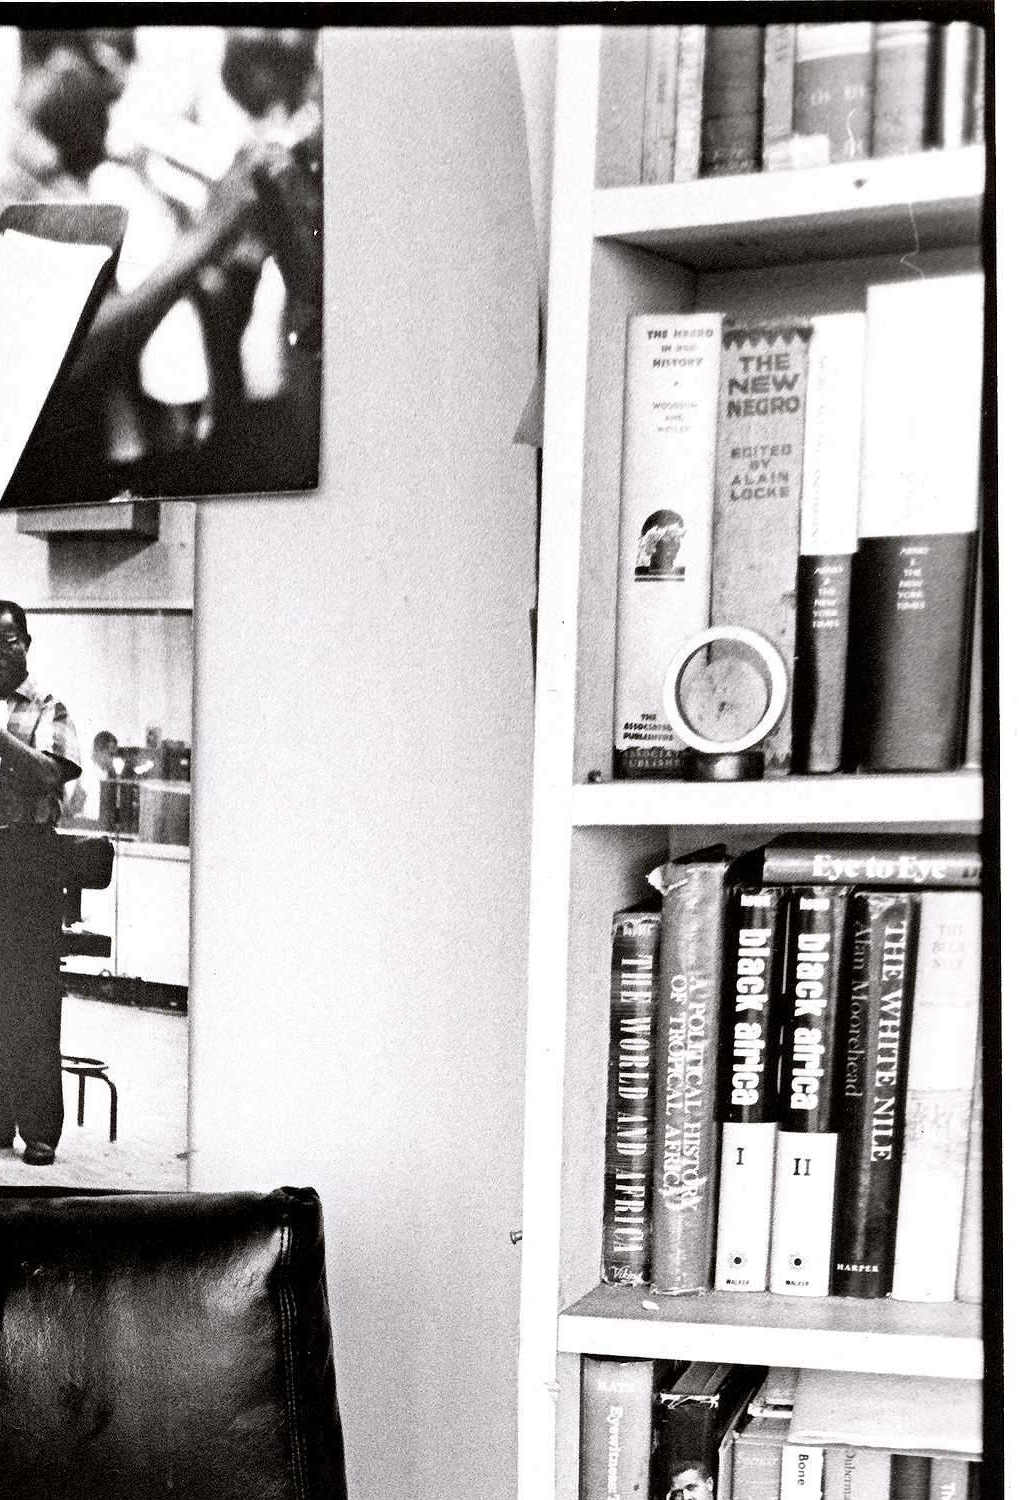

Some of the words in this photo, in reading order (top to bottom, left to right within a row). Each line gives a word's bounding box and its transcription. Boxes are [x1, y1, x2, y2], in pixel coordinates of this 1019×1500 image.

[646, 329, 668, 340] THE
[652, 357, 704, 368] HISTORY
[727, 373, 800, 397] NEW
[739, 352, 791, 374] THE
[725, 396, 800, 418] NEGRO
[730, 444, 792, 459] EDITED
[748, 459, 770, 470] BY
[730, 486, 790, 502] LOCKE
[731, 471, 789, 486] ALAIN
[812, 854, 860, 880] Eye
[865, 855, 894, 878] to
[897, 855, 948, 880] Eye
[736, 928, 772, 1012] black
[854, 919, 872, 976] Alan
[882, 922, 908, 982] THE
[621, 954, 653, 1003] THE
[670, 973, 687, 1003] OF
[795, 933, 830, 1017] black
[618, 1017, 652, 1100] WORLD
[684, 1001, 706, 1113] POLITICAL
[845, 981, 869, 1098] Moorehead
[875, 990, 902, 1088] WHITE
[665, 1012, 687, 1115] TROPICAL
[731, 1022, 766, 1106] africa
[790, 1027, 825, 1110] africa
[615, 1111, 649, 1156] AND
[870, 1096, 895, 1163] NILE
[661, 1123, 682, 1200] AFRICA
[681, 1122, 707, 1211] HISTORY
[735, 1147, 745, 1165] I
[793, 1158, 812, 1177] II
[612, 1168, 646, 1253] AFRICA
[836, 1263, 879, 1273] HARPER
[797, 1453, 810, 1486] Bone
